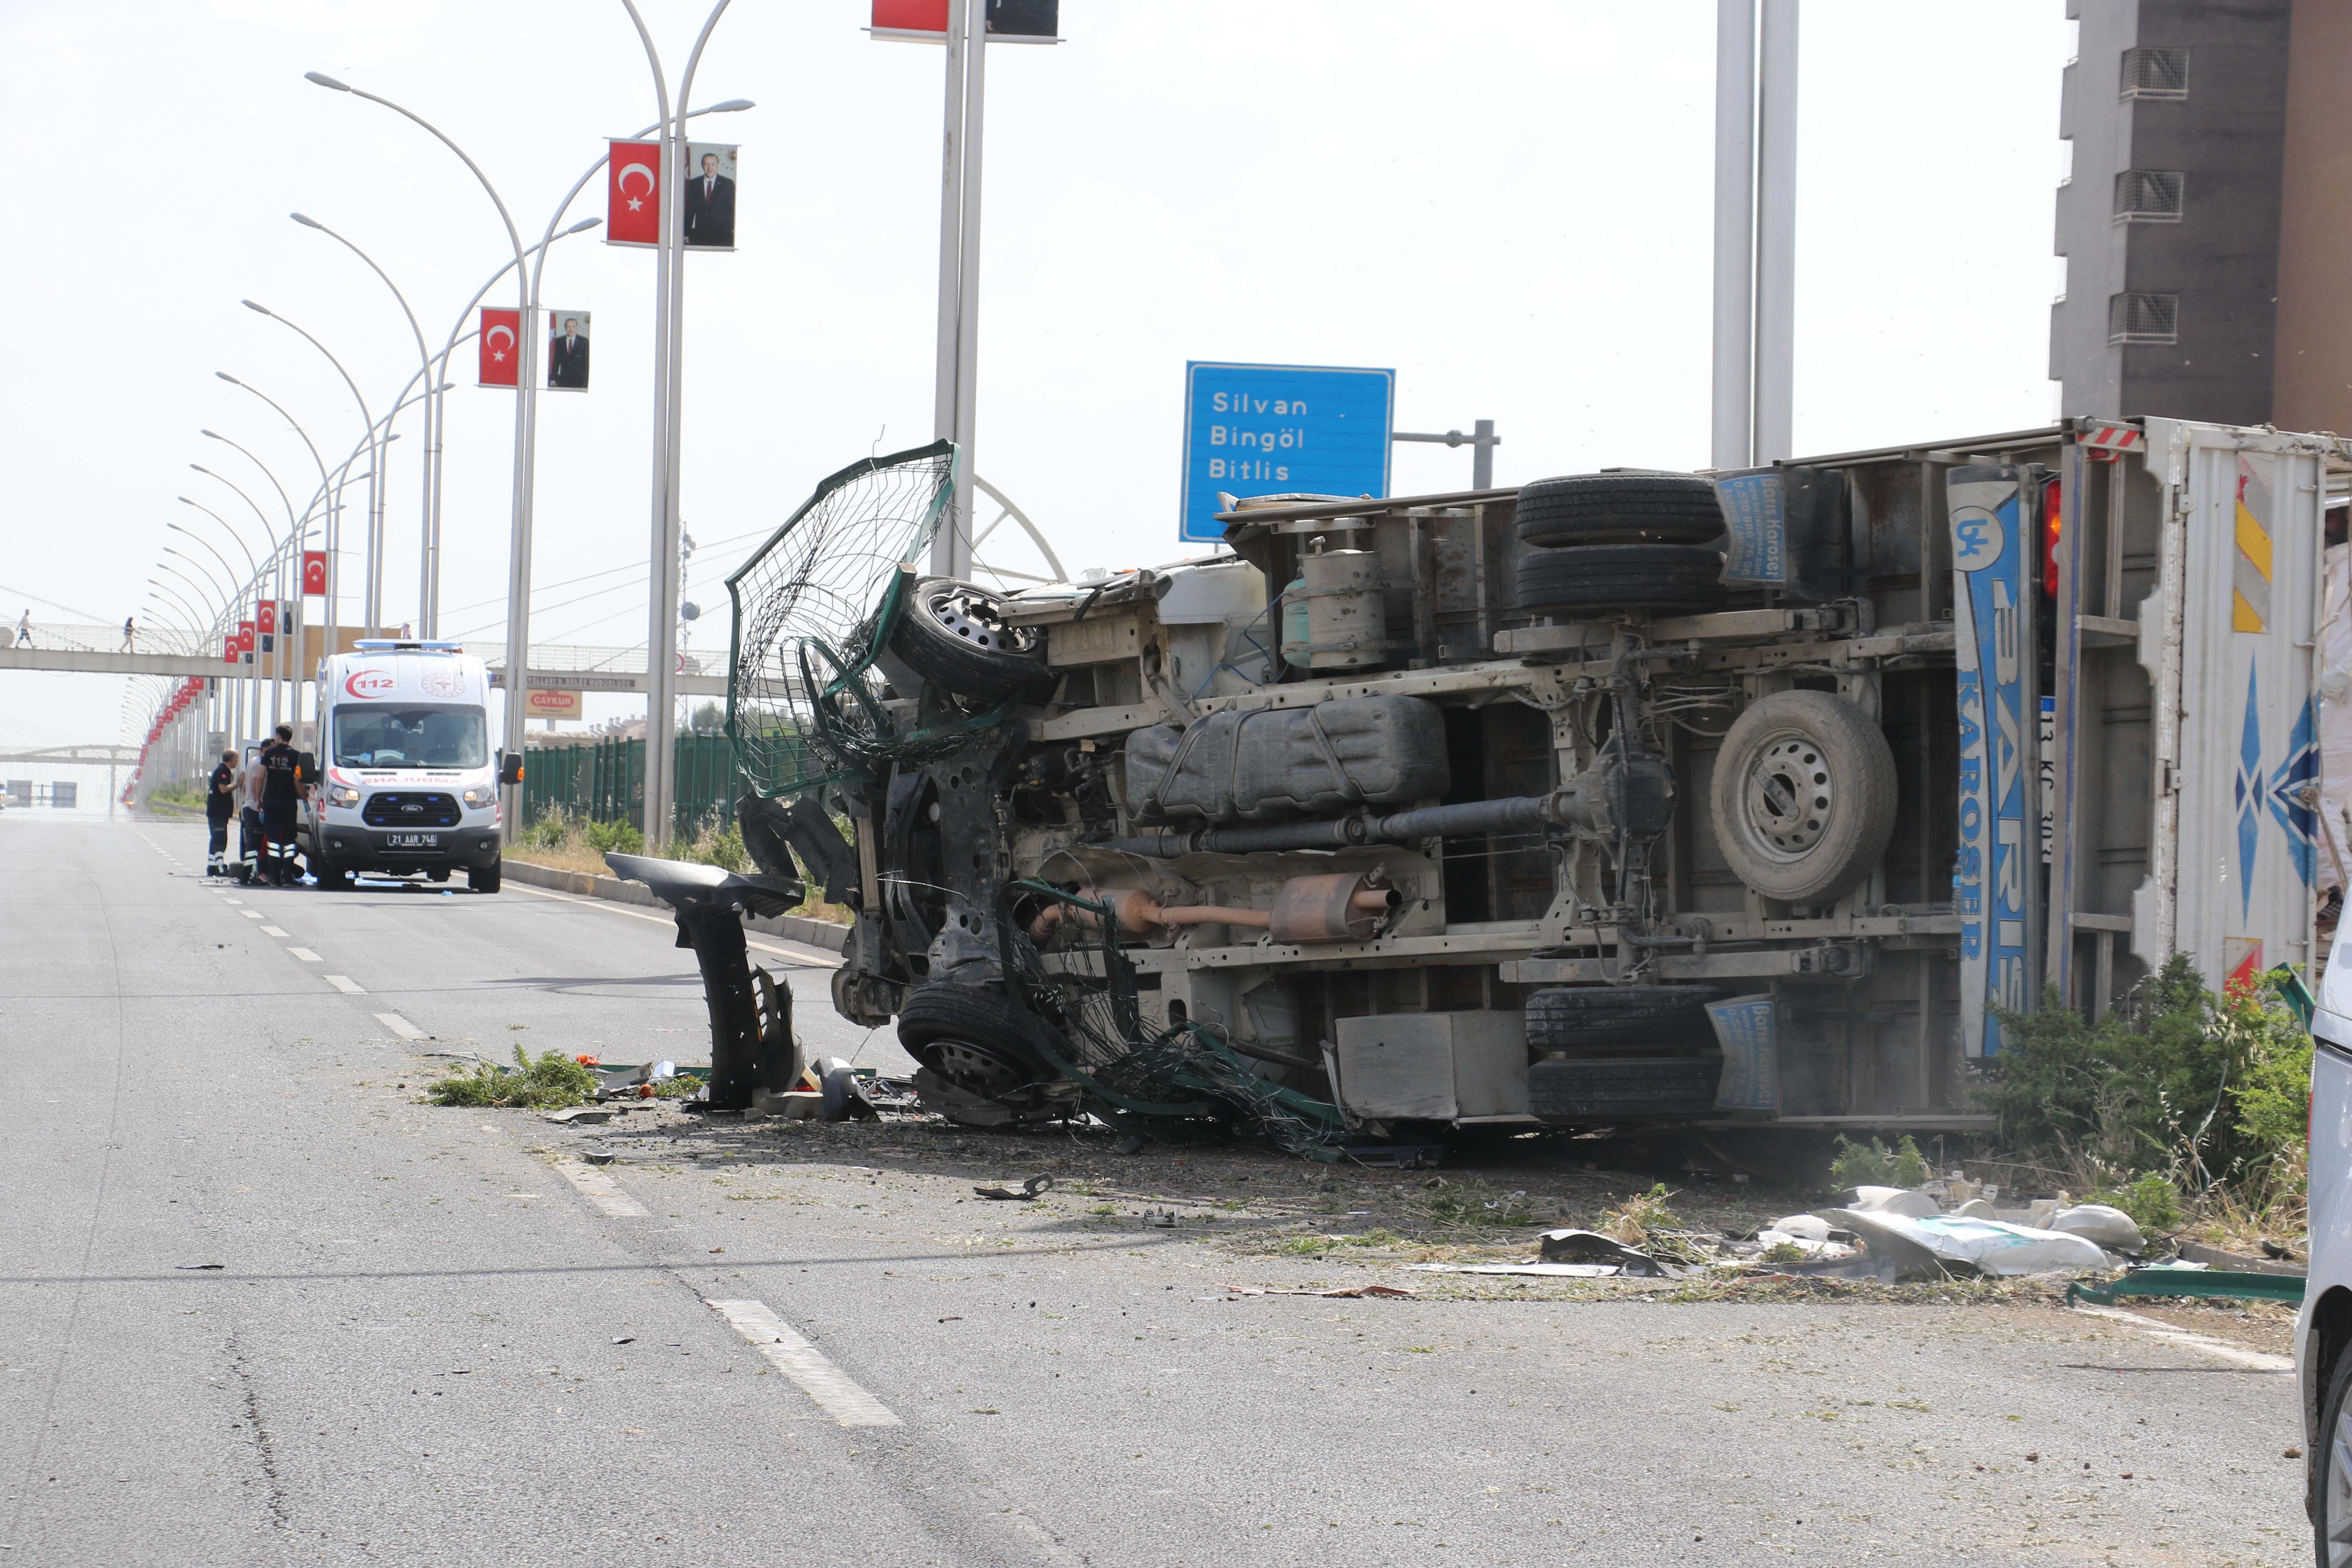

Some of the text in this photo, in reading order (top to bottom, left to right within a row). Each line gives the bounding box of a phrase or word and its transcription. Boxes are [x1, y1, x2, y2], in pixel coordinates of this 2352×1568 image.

[1212, 392, 1308, 416] Silvan
[1210, 426, 1303, 453] Bingöl
[1209, 458, 1289, 481] Bitlis
[1766, 519, 1782, 577] Karoser
[356, 679, 393, 688] 112
[533, 696, 571, 705] ÇAYKUR
[270, 756, 288, 766] 112
[1957, 668, 1982, 962] KAROSER
[392, 835, 435, 843] 21 AAR 746
